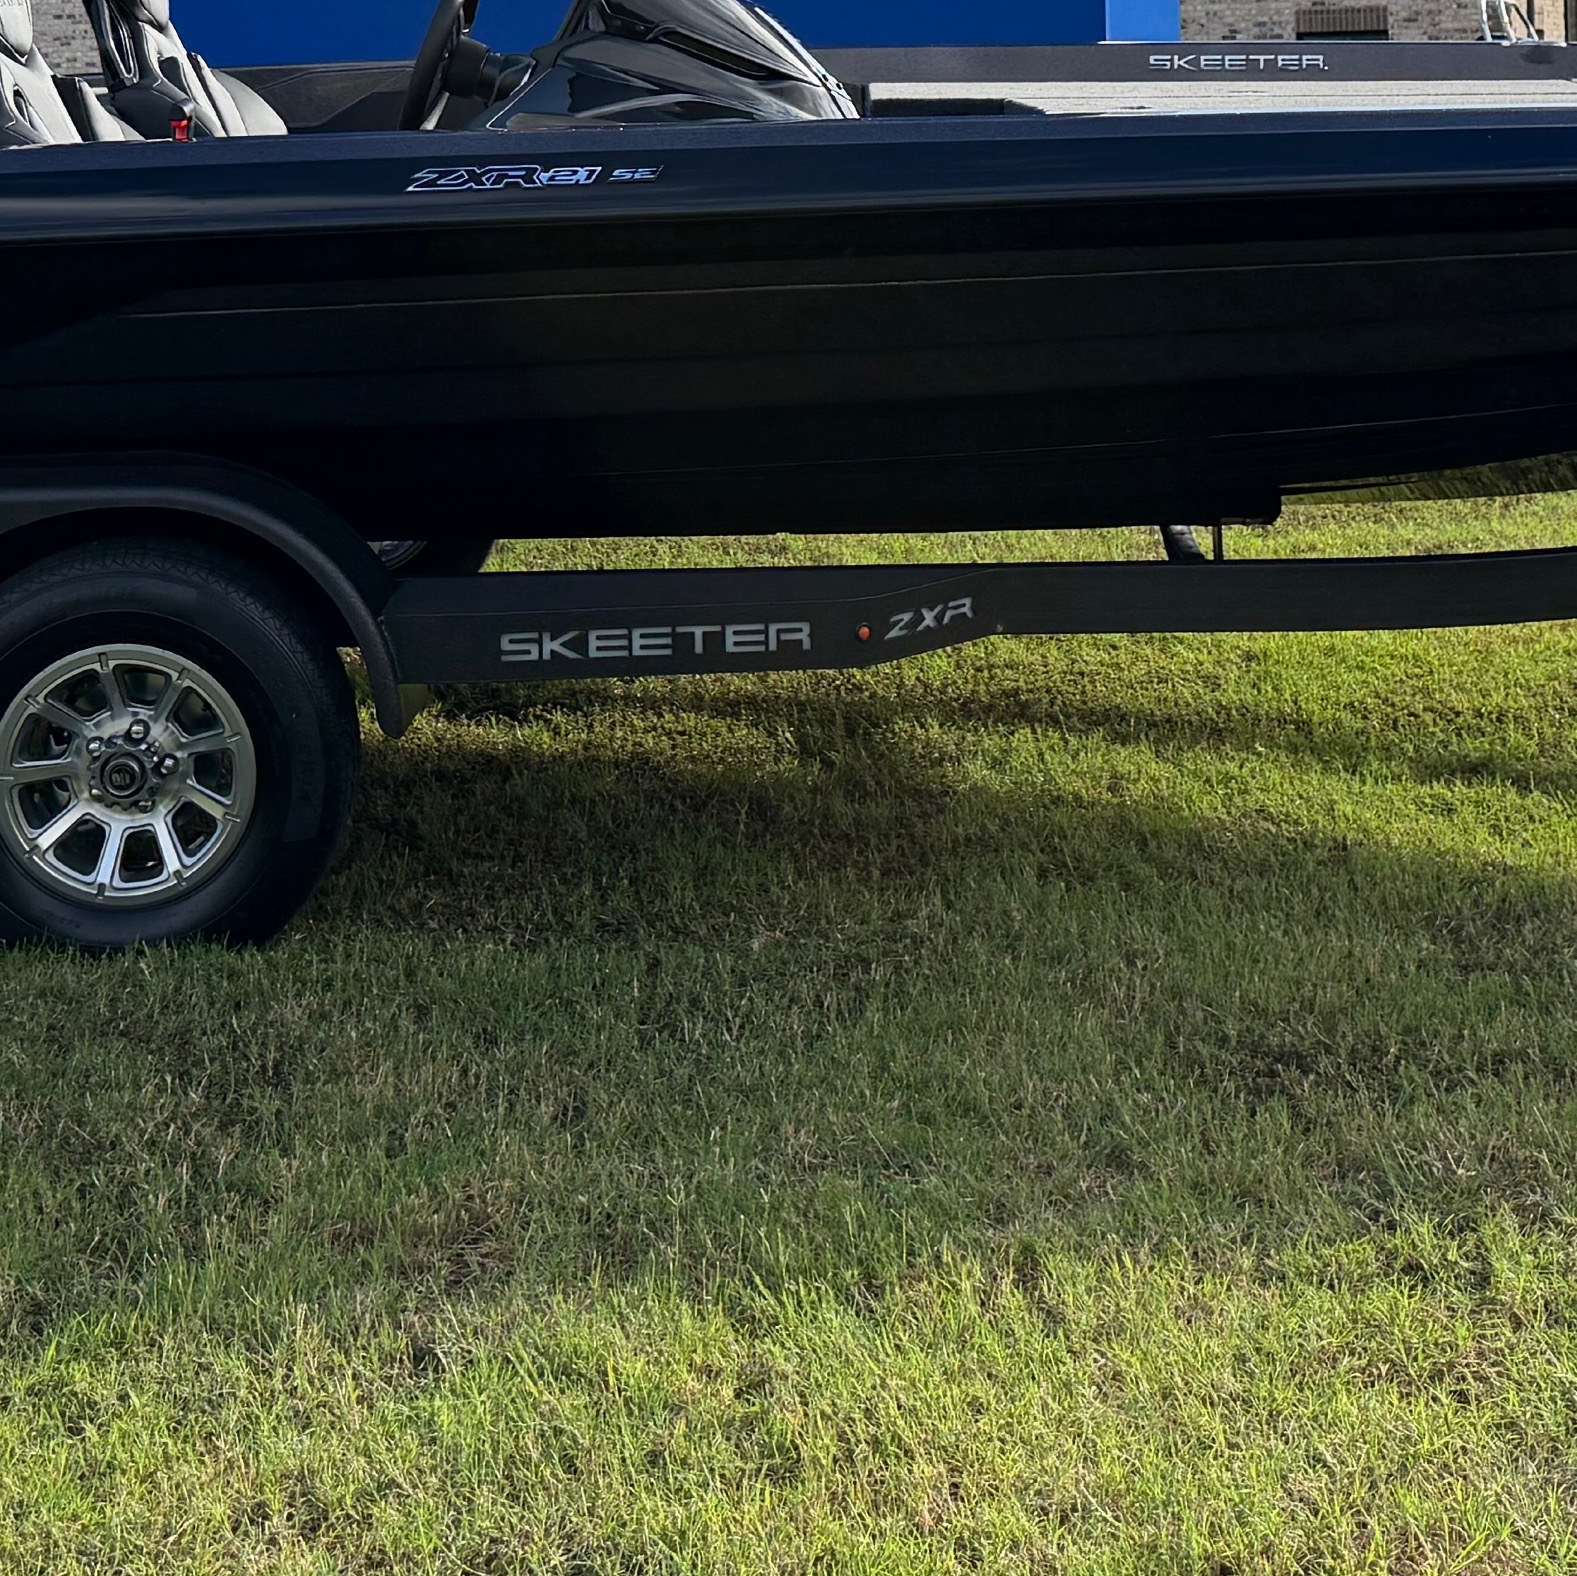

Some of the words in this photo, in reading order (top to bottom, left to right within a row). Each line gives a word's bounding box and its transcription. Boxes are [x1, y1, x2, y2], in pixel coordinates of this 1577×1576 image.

[1149, 54, 1325, 72] SKEETER
[608, 167, 662, 182] SE
[500, 621, 812, 663] SKEETER
[884, 596, 976, 640] ZXR
